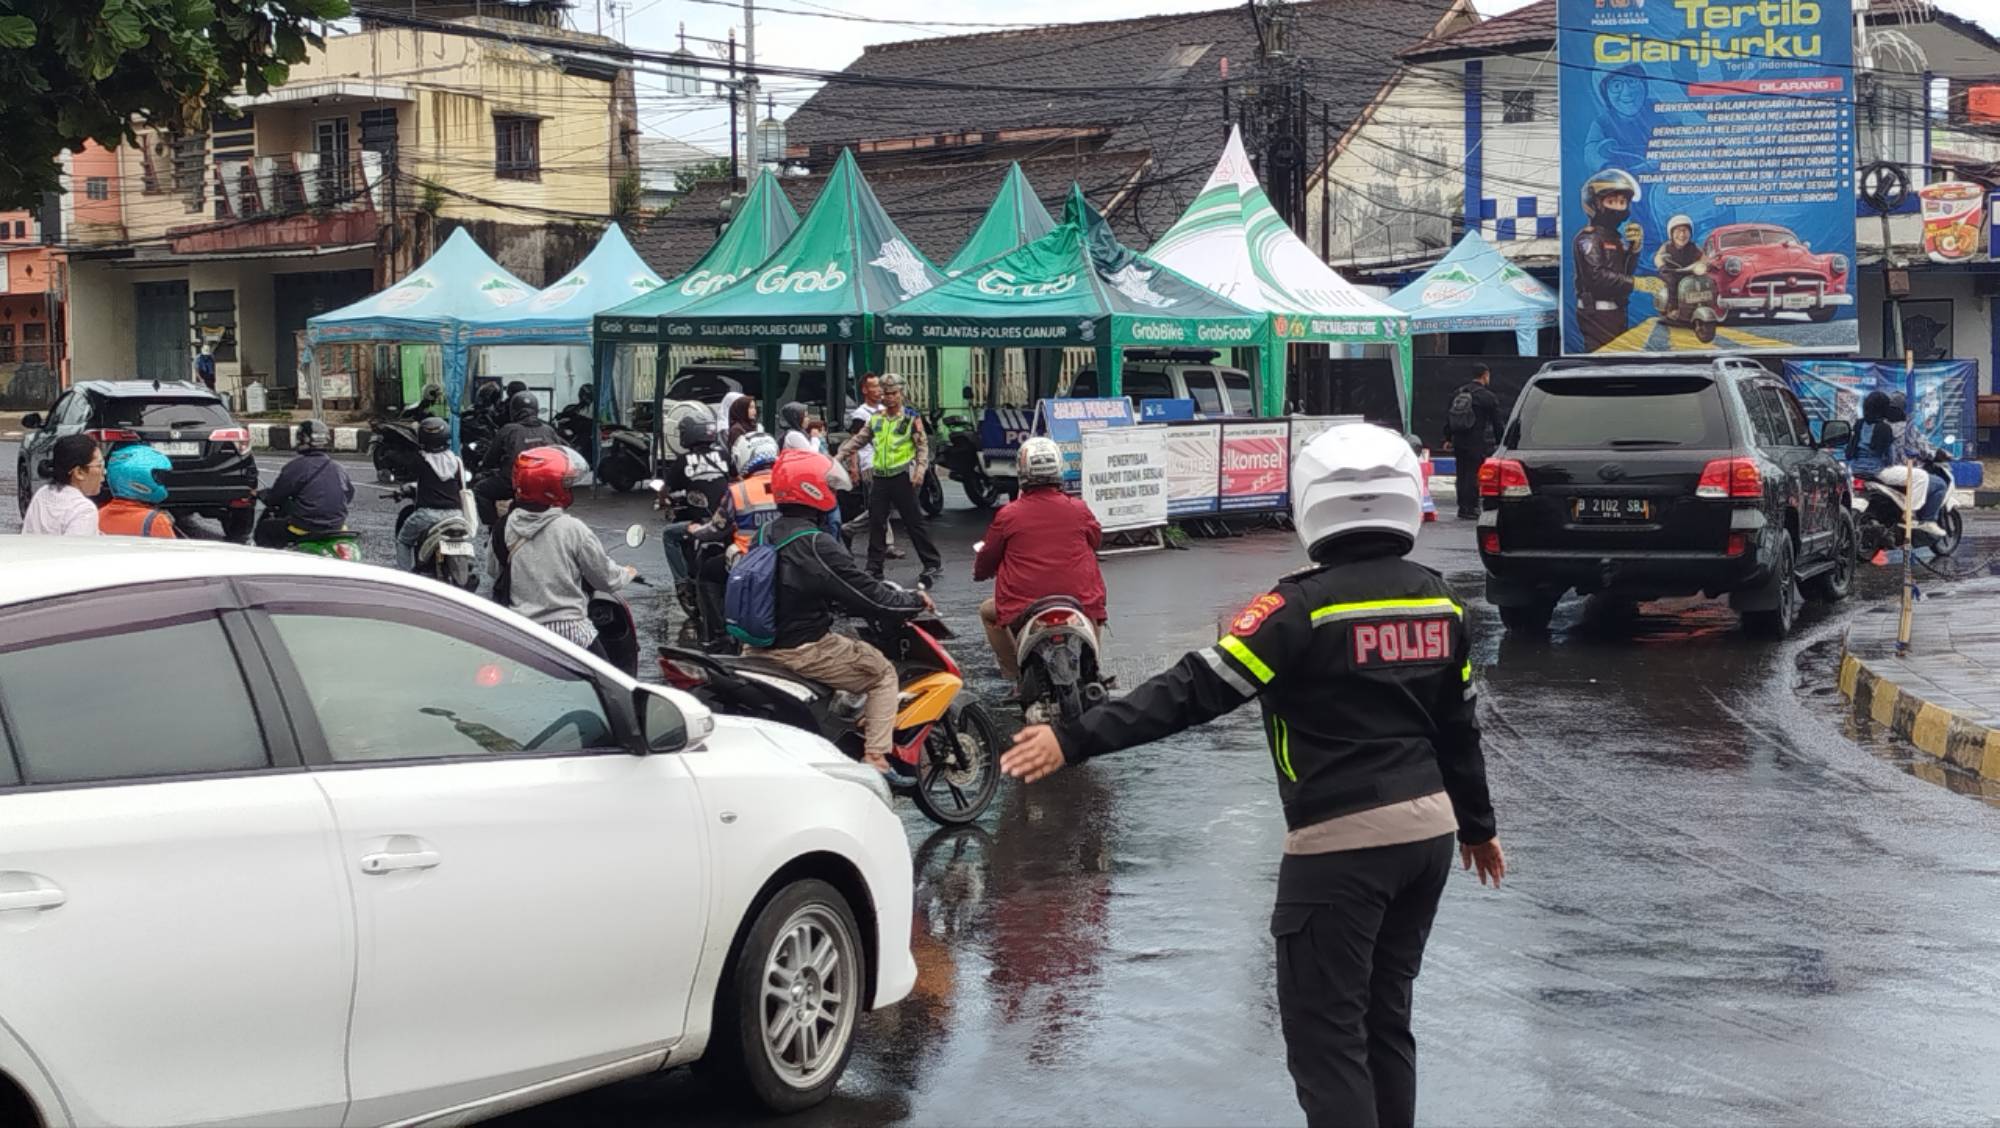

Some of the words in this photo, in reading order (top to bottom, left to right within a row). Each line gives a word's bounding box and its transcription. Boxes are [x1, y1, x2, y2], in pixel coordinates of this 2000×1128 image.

[1674, 0, 1822, 29] Tertib
[1593, 29, 1822, 67] Cianjurku
[1759, 81, 1829, 92] DILARANG
[1654, 102, 1714, 113] BERKENDARA
[1715, 101, 1745, 111] DALAM
[1707, 112, 1767, 122] BERKENDARA
[1812, 109, 1837, 118] ARUS
[1653, 126, 1712, 136] BERKENDARA
[1785, 121, 1837, 131] KECEPATAN
[1648, 137, 1716, 148] MENGGUNAKAN
[1717, 136, 1751, 146] PONSEL
[1753, 135, 1777, 144] SAAT
[1778, 132, 1837, 143] BERKENDARA
[1759, 158, 1780, 168] DARI
[1781, 157, 1806, 167] SATU
[1806, 155, 1837, 165] ORANG
[1638, 174, 1663, 184] TIDAK
[1665, 172, 1733, 183] MENGGUNAKAN
[1815, 167, 1838, 177] BELT
[1667, 184, 1735, 194] MENGGUNAKAN
[681, 267, 752, 296] Gra
[755, 260, 847, 295] Grab
[600, 321, 623, 333] Grab
[667, 322, 693, 336] Grab
[700, 324, 751, 336] SATLANTAS
[751, 324, 788, 336] POLRES
[788, 323, 828, 335] CIANJUR
[883, 322, 913, 336] Grab
[922, 325, 980, 338] SATLANTAS
[980, 325, 1022, 338] POLRES
[1023, 325, 1067, 338] CIANJUR
[1131, 321, 1184, 341] GrabBike
[1198, 323, 1252, 341] GrabFood
[1222, 447, 1283, 471] elkomsel
[1089, 471, 1121, 486] KNALPOT
[1578, 498, 1585, 511] B
[1593, 498, 1619, 513] 2102
[1354, 620, 1450, 665] POLISI
